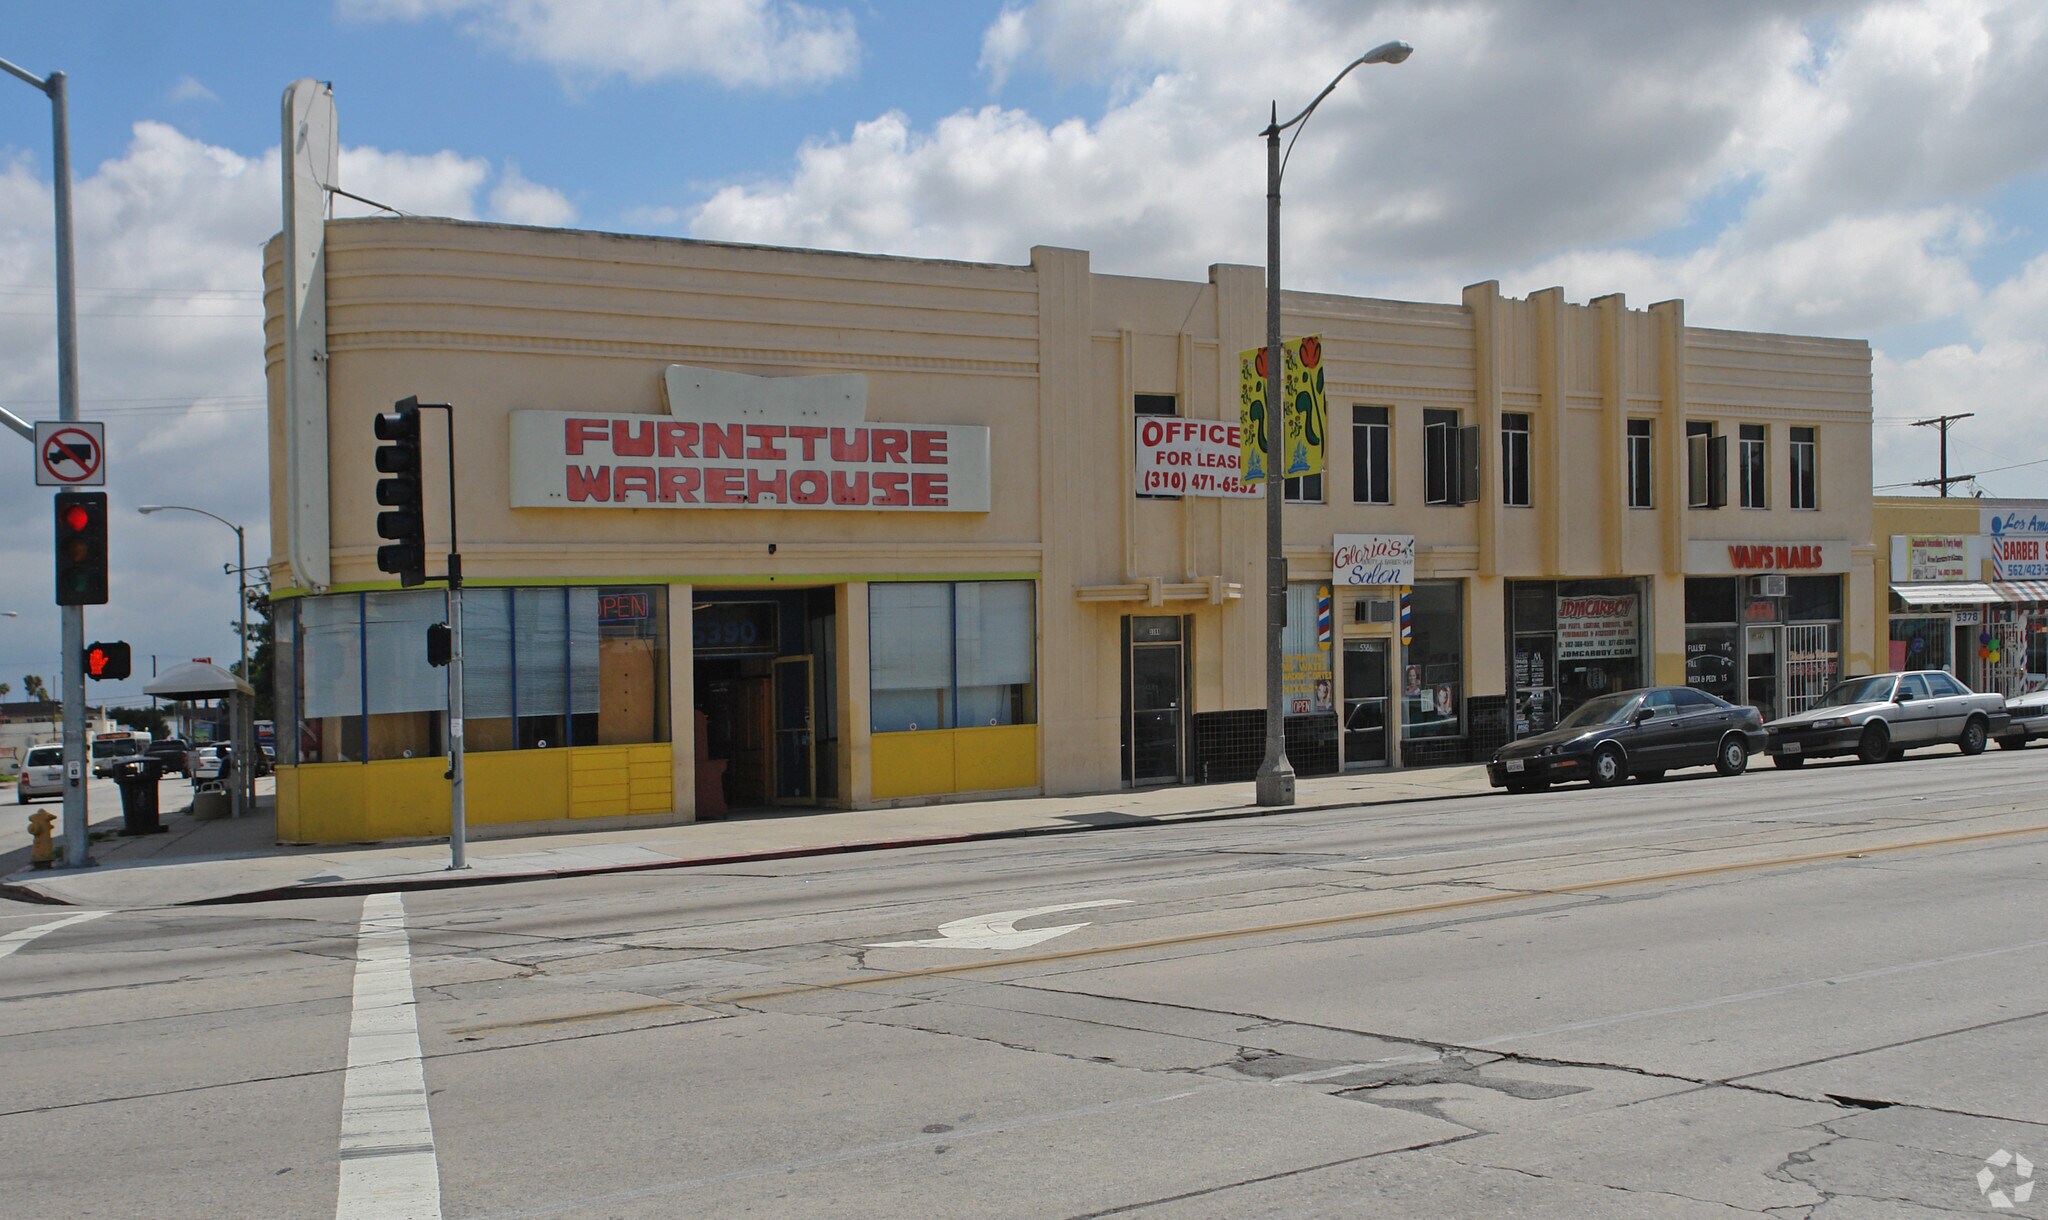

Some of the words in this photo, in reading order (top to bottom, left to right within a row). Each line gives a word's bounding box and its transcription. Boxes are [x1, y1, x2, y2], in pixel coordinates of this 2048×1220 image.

[565, 418, 948, 465] FURNITURE
[1156, 451, 1192, 466] FOR
[1197, 453, 1241, 469] LEAS
[565, 464, 949, 506] WAREHOUSE
[1144, 470, 1187, 493] (310)
[2003, 512, 2026, 530] Los
[1335, 537, 1402, 569] Gloria's
[1728, 545, 1774, 569] VAN'S
[1775, 545, 1823, 569] NAILS
[2003, 541, 2039, 560] BARBER
[1348, 563, 1401, 585] Salon
[1558, 598, 1633, 618] JDMCARBOY
[1956, 611, 1978, 622] 5378
[1561, 648, 1632, 658] JDMCARBOY.COM
[1293, 701, 1310, 712] OPEN
